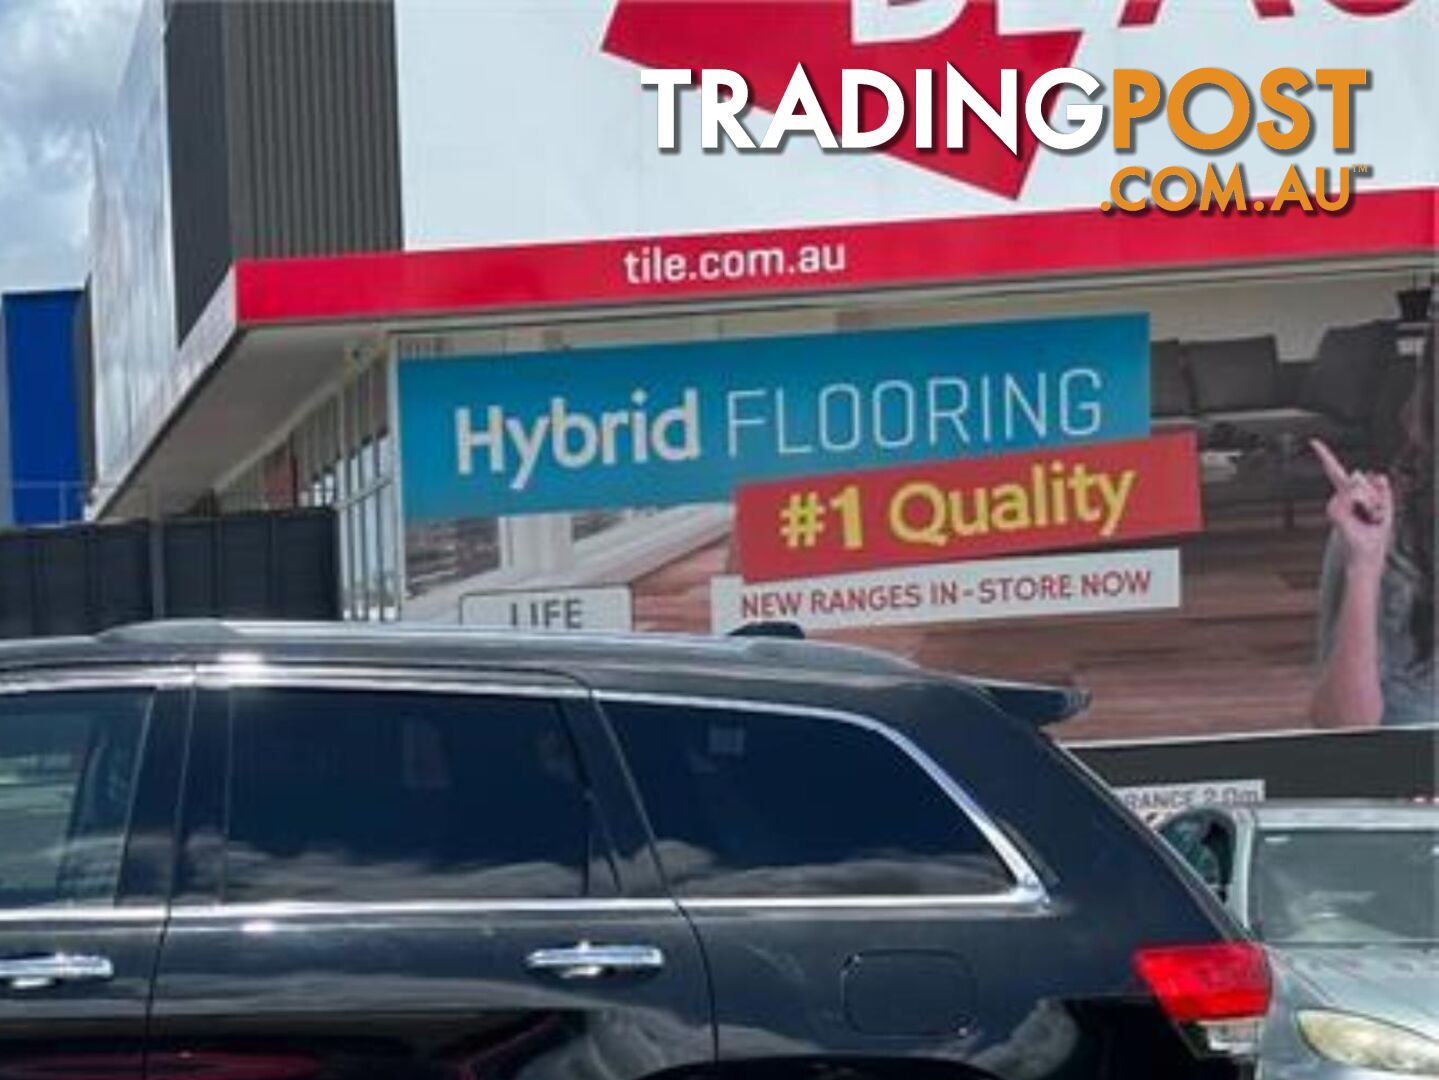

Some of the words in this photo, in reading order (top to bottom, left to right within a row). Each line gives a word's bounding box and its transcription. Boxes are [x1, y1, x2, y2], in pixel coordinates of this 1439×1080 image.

[623, 242, 846, 284] tile.com.au
[456, 387, 700, 490] Hybrid
[726, 368, 1102, 458] FLOORING
[779, 485, 863, 549] #1
[889, 459, 1138, 547] Quality
[741, 589, 802, 619] NEW
[811, 584, 922, 615] RANGES
[1080, 569, 1153, 598] NOW
